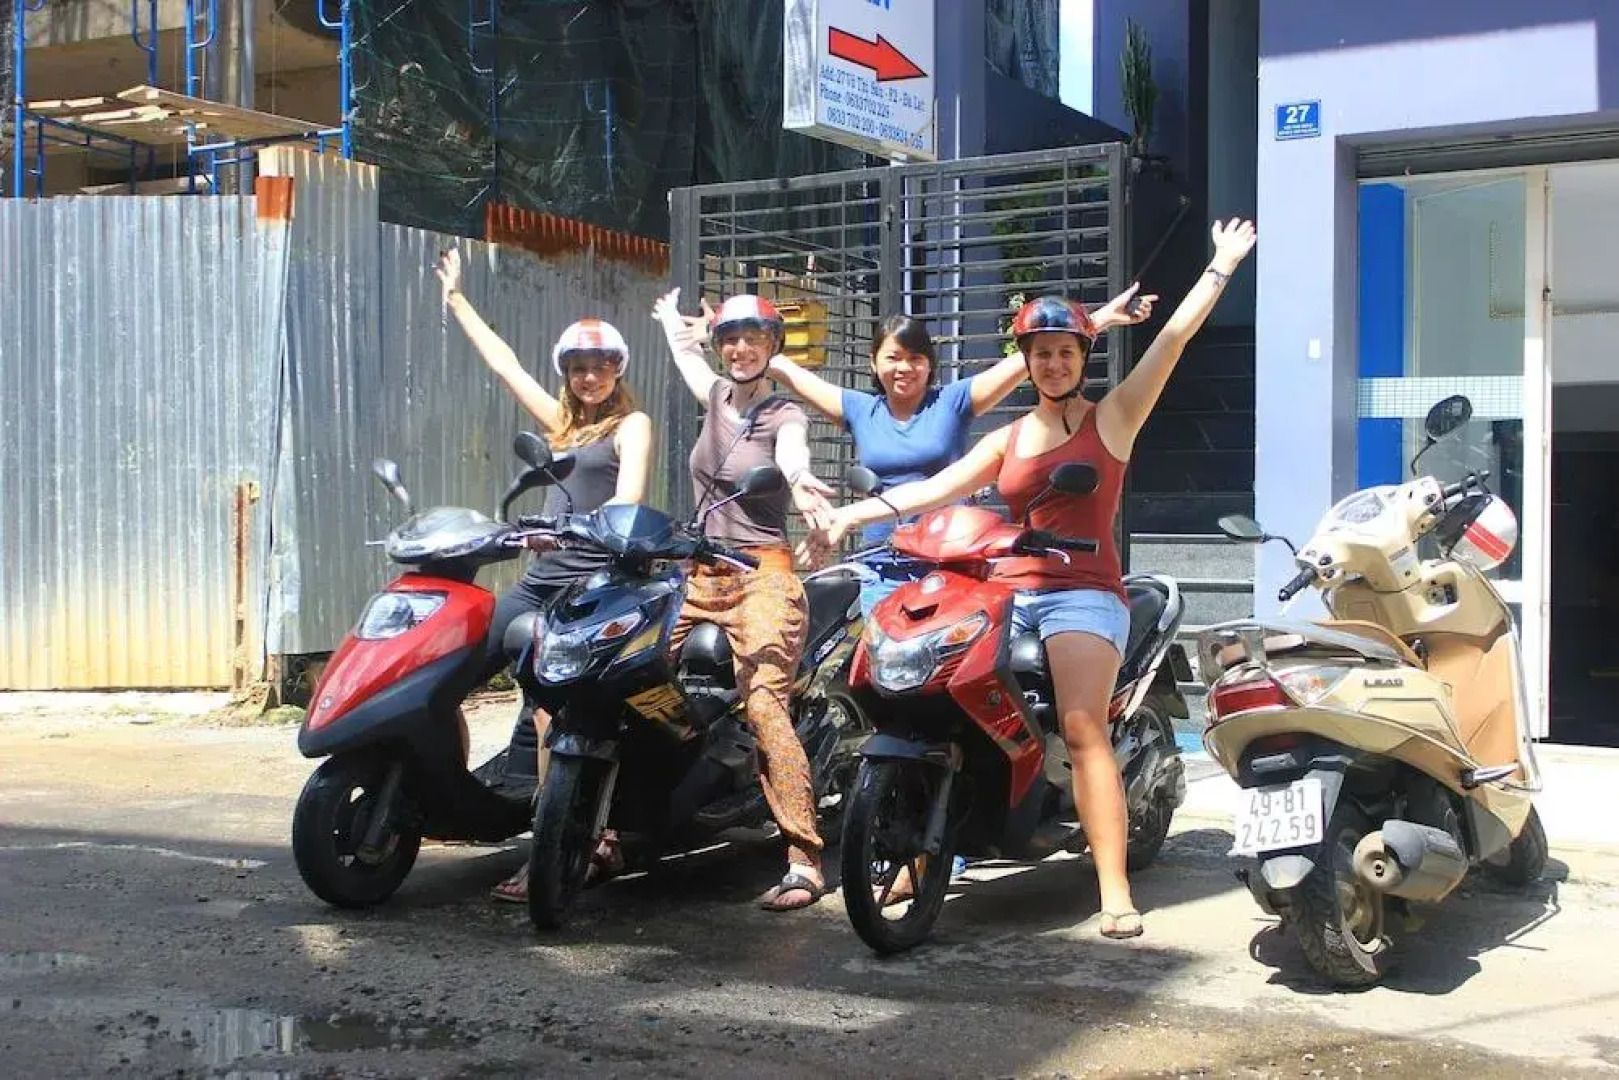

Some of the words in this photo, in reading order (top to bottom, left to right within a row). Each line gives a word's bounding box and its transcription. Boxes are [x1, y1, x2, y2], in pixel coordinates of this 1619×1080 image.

[1286, 104, 1310, 123] 27
[1363, 678, 1404, 688] LEAD
[1241, 814, 1316, 849] 242.59
